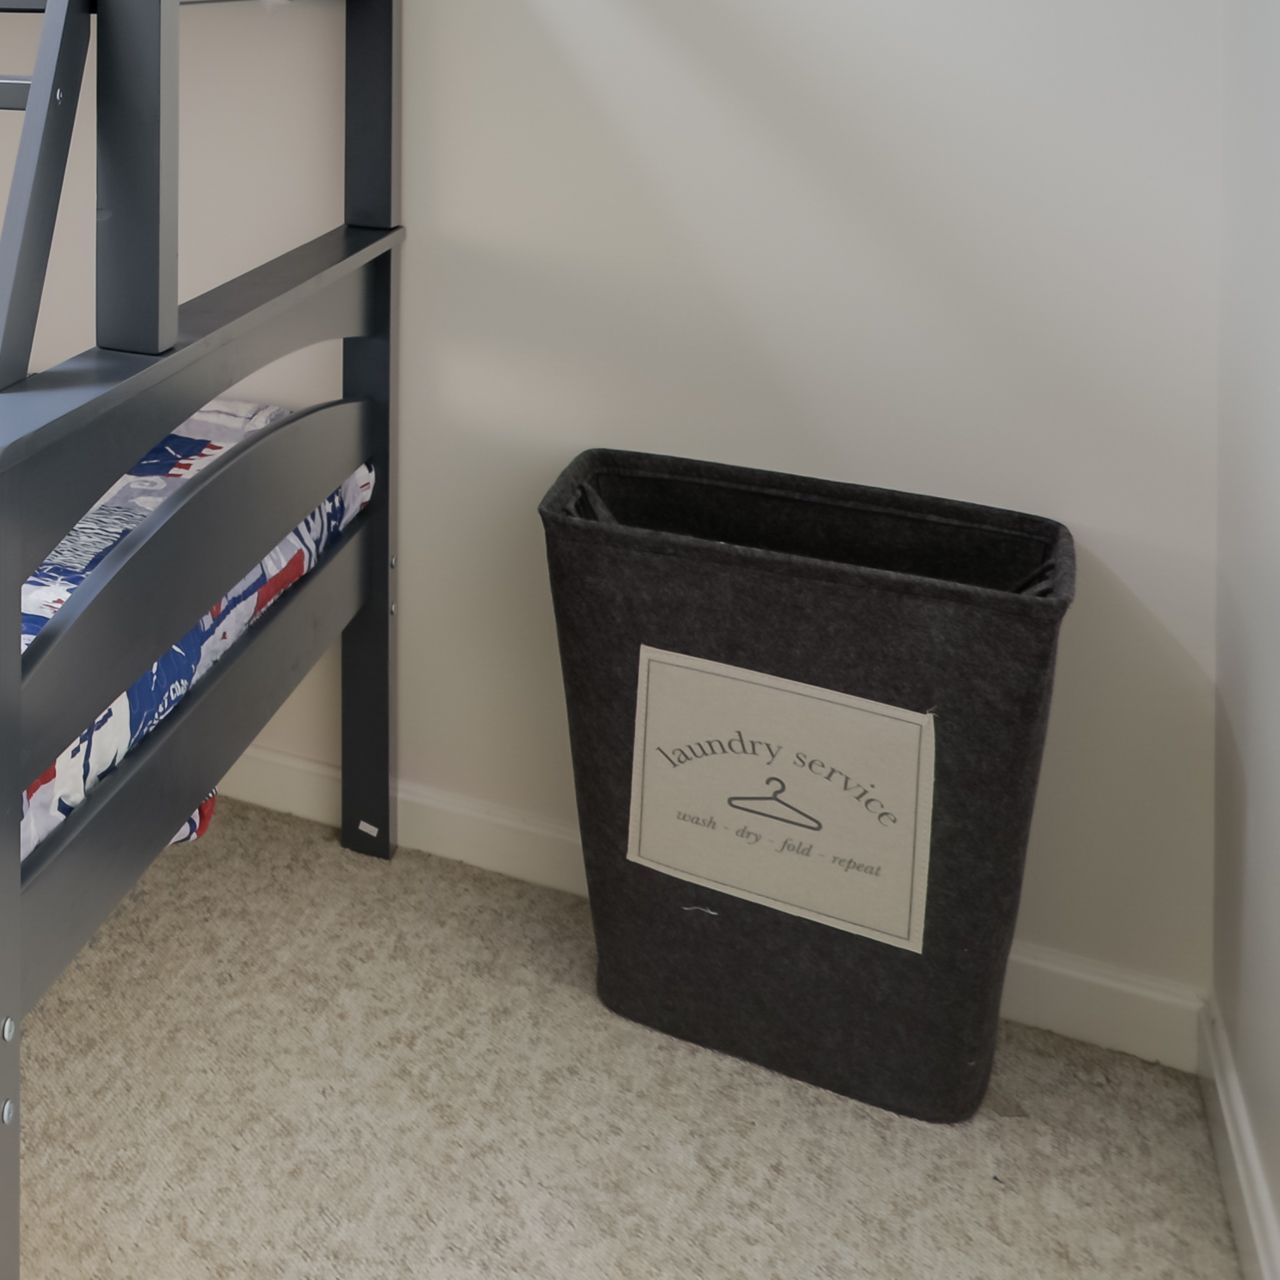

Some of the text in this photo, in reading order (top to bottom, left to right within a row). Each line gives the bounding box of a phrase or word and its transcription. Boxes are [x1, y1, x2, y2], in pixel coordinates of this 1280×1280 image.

[656, 731, 898, 827] laundry service
[676, 811, 718, 831] wash
[735, 825, 763, 844] dry
[776, 838, 814, 858] fold
[831, 855, 882, 878] repeat
